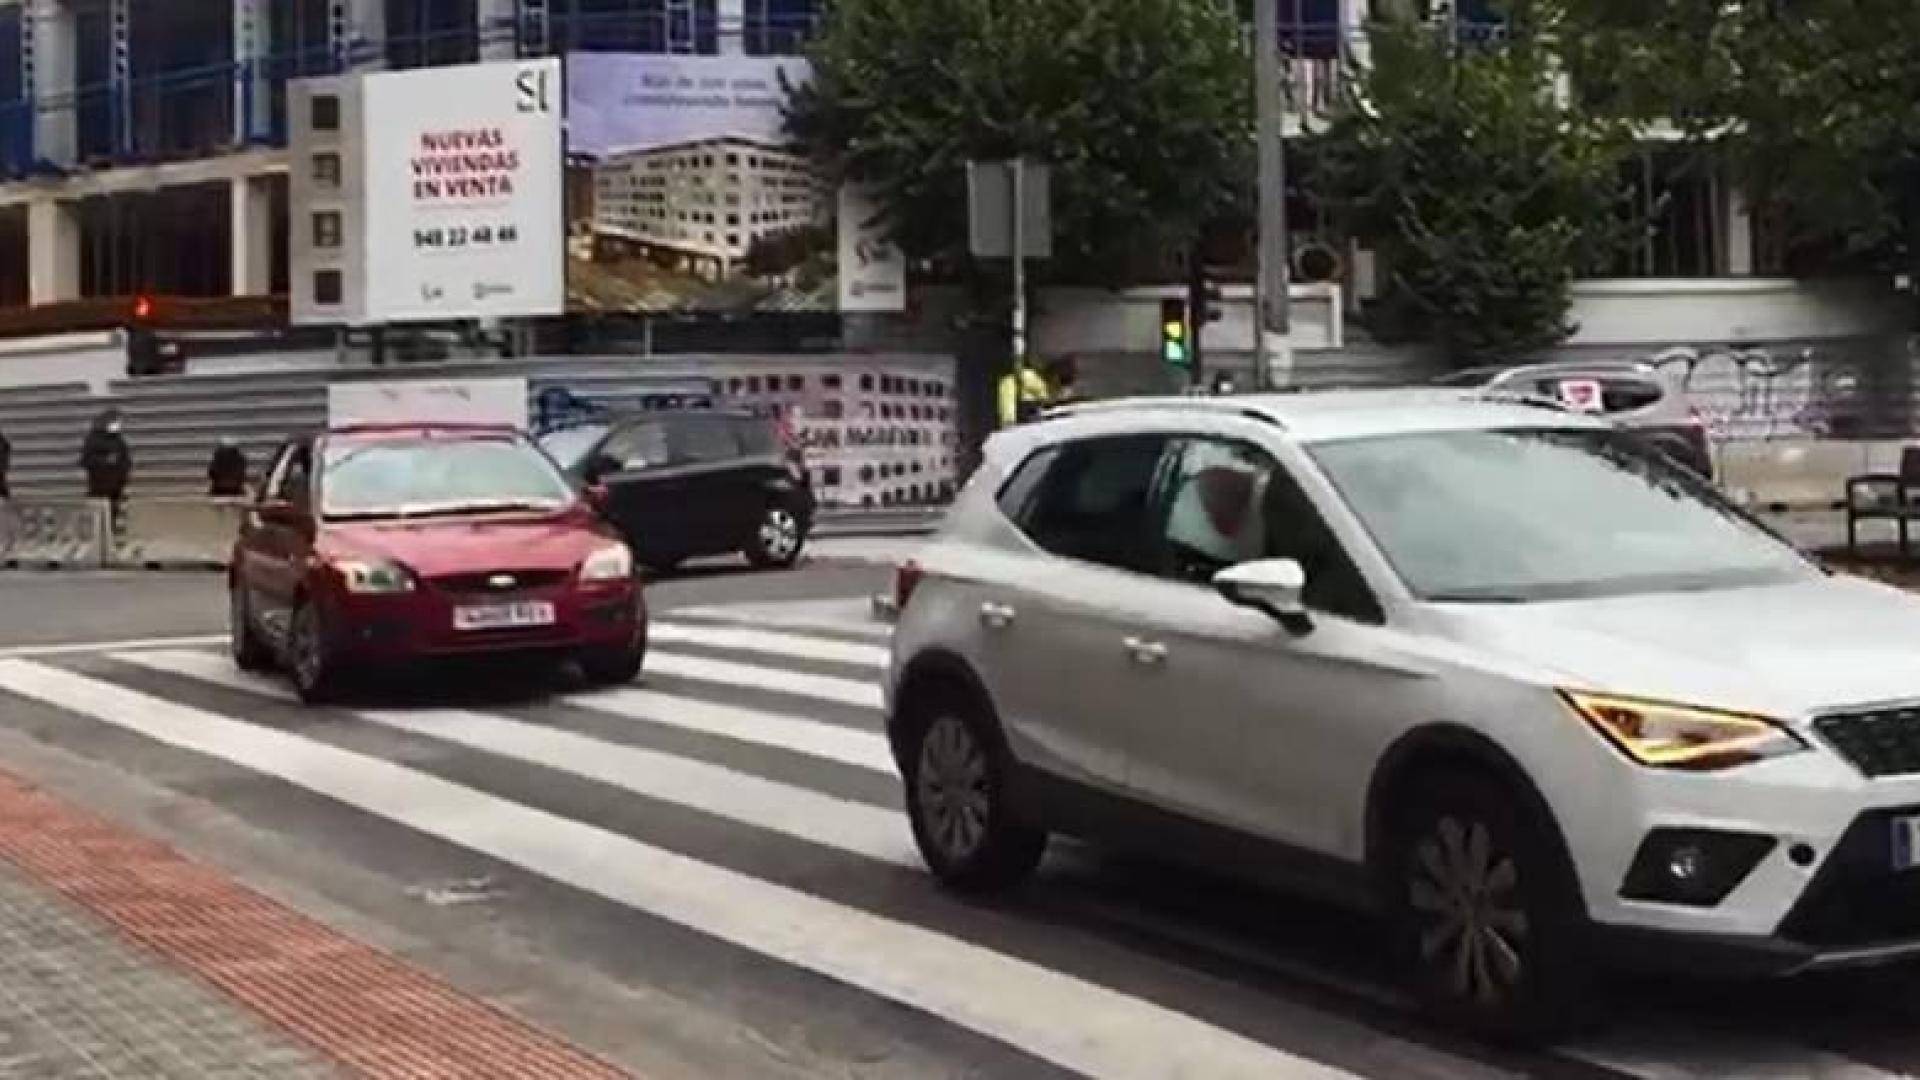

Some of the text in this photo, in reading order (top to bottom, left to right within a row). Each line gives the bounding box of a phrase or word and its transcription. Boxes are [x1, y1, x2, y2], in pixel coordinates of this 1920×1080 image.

[420, 128, 503, 150] NUEVAS
[410, 150, 519, 175] VIVIENDAS
[413, 174, 513, 199] EN VENTA
